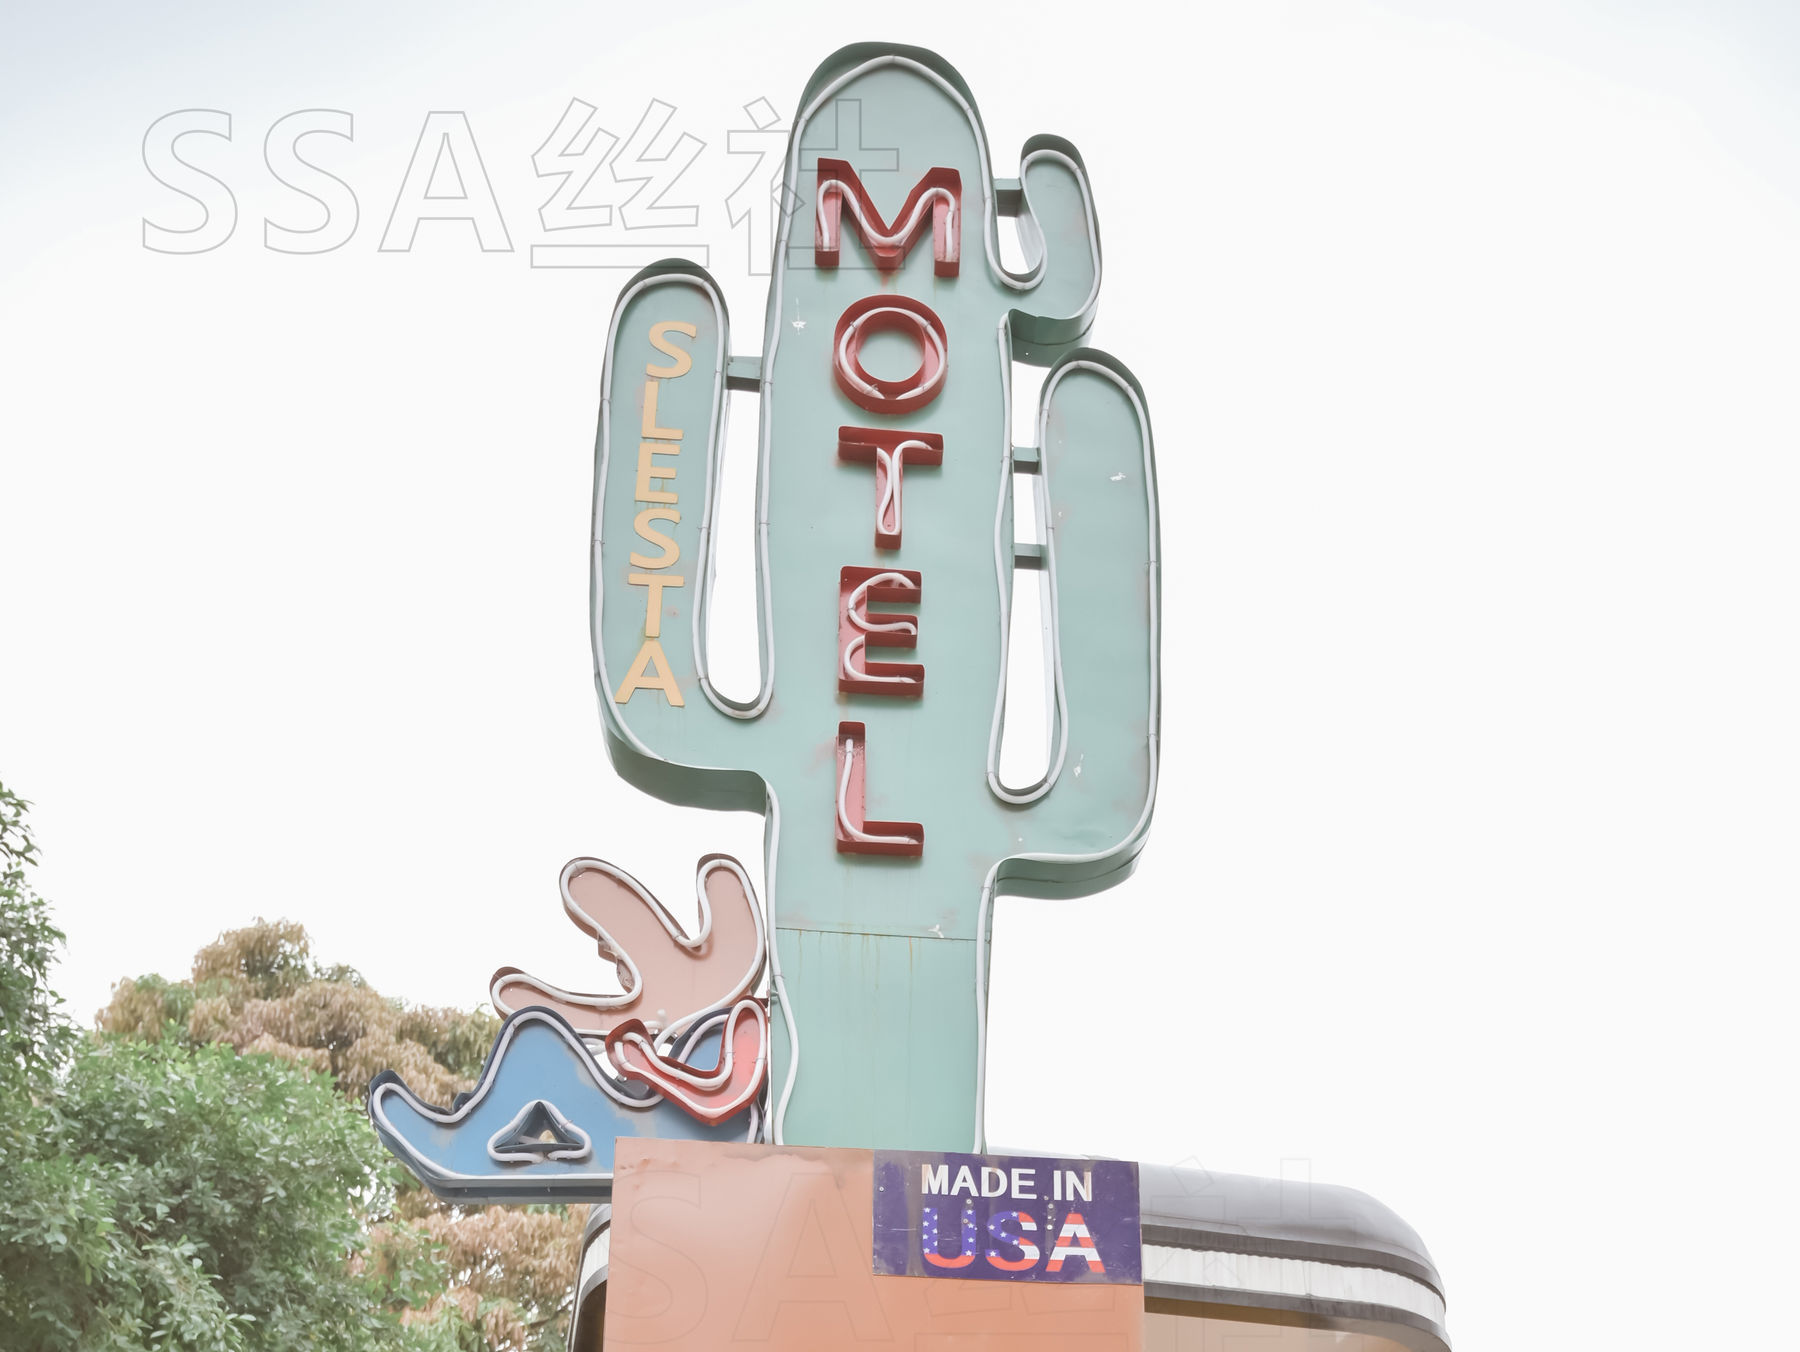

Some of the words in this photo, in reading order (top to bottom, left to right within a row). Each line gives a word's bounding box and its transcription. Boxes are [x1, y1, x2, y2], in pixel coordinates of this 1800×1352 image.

[613, 320, 698, 708] SLESTA
[815, 157, 962, 858] MOTEL
[921, 1163, 1037, 1200] MADE
[1053, 1169, 1092, 1202] IN
[922, 1207, 1106, 1273] USA
